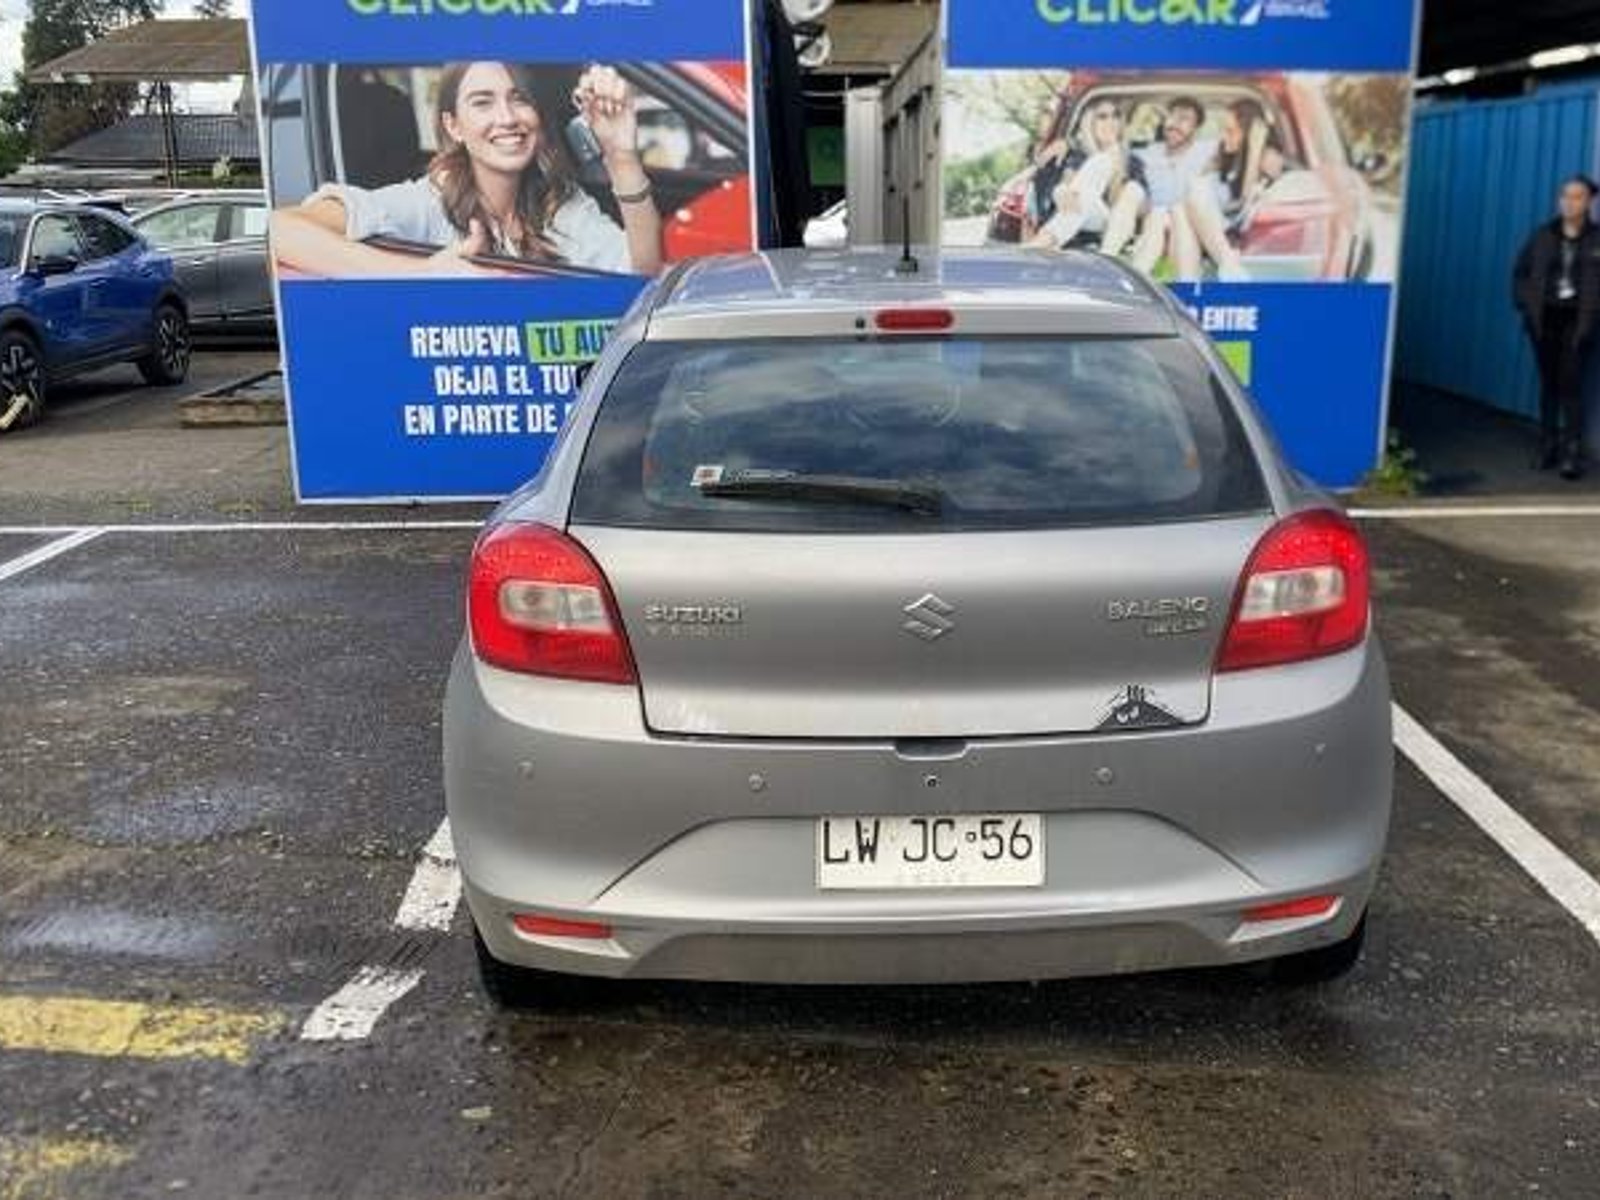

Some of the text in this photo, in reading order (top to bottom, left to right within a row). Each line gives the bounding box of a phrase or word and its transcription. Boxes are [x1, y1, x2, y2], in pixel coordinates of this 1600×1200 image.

[410, 325, 521, 358] RENUEVA
[535, 327, 565, 357] TU
[434, 365, 499, 396] DEJA
[505, 365, 534, 396] EL
[404, 405, 436, 436] EN
[442, 405, 521, 435] PARTE
[526, 404, 558, 433] DE
